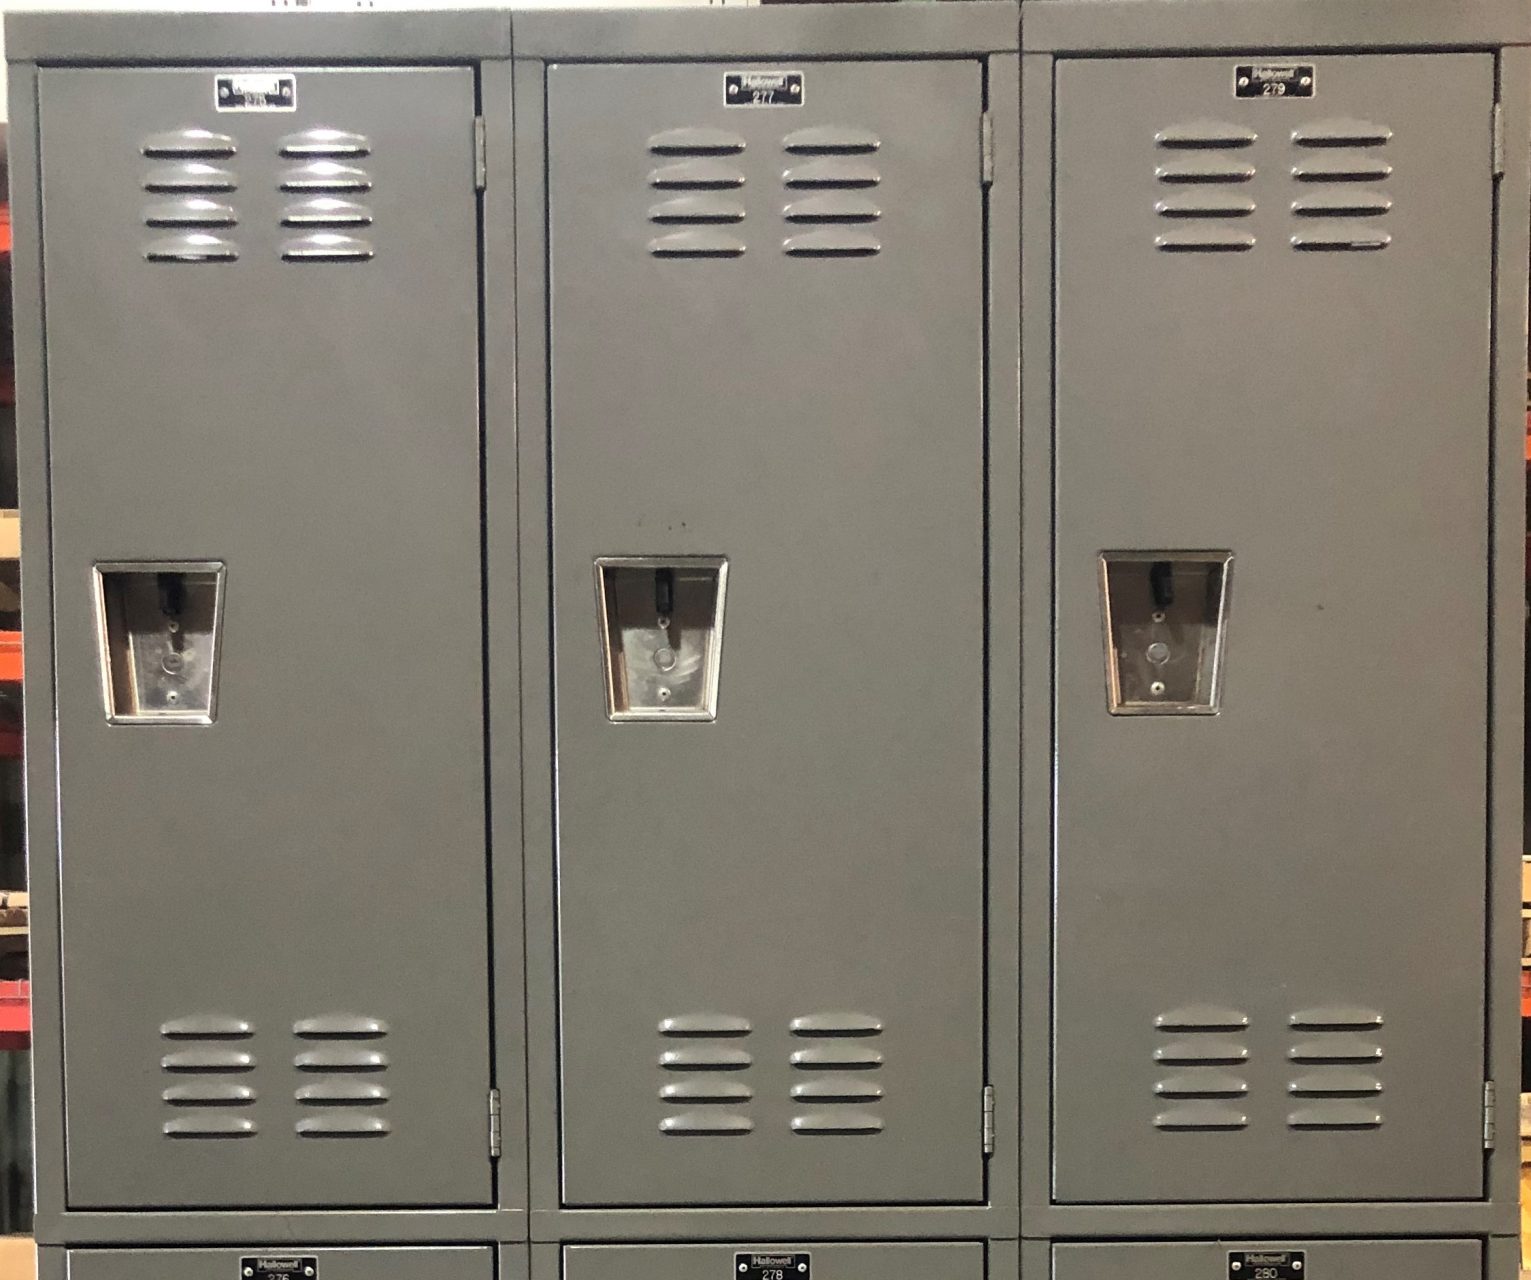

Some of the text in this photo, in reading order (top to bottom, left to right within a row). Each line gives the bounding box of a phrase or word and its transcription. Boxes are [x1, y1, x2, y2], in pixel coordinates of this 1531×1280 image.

[1263, 83, 1286, 96] 279
[752, 91, 774, 104] 277
[753, 1256, 791, 1265] Hallowell
[762, 1269, 783, 1280] 278
